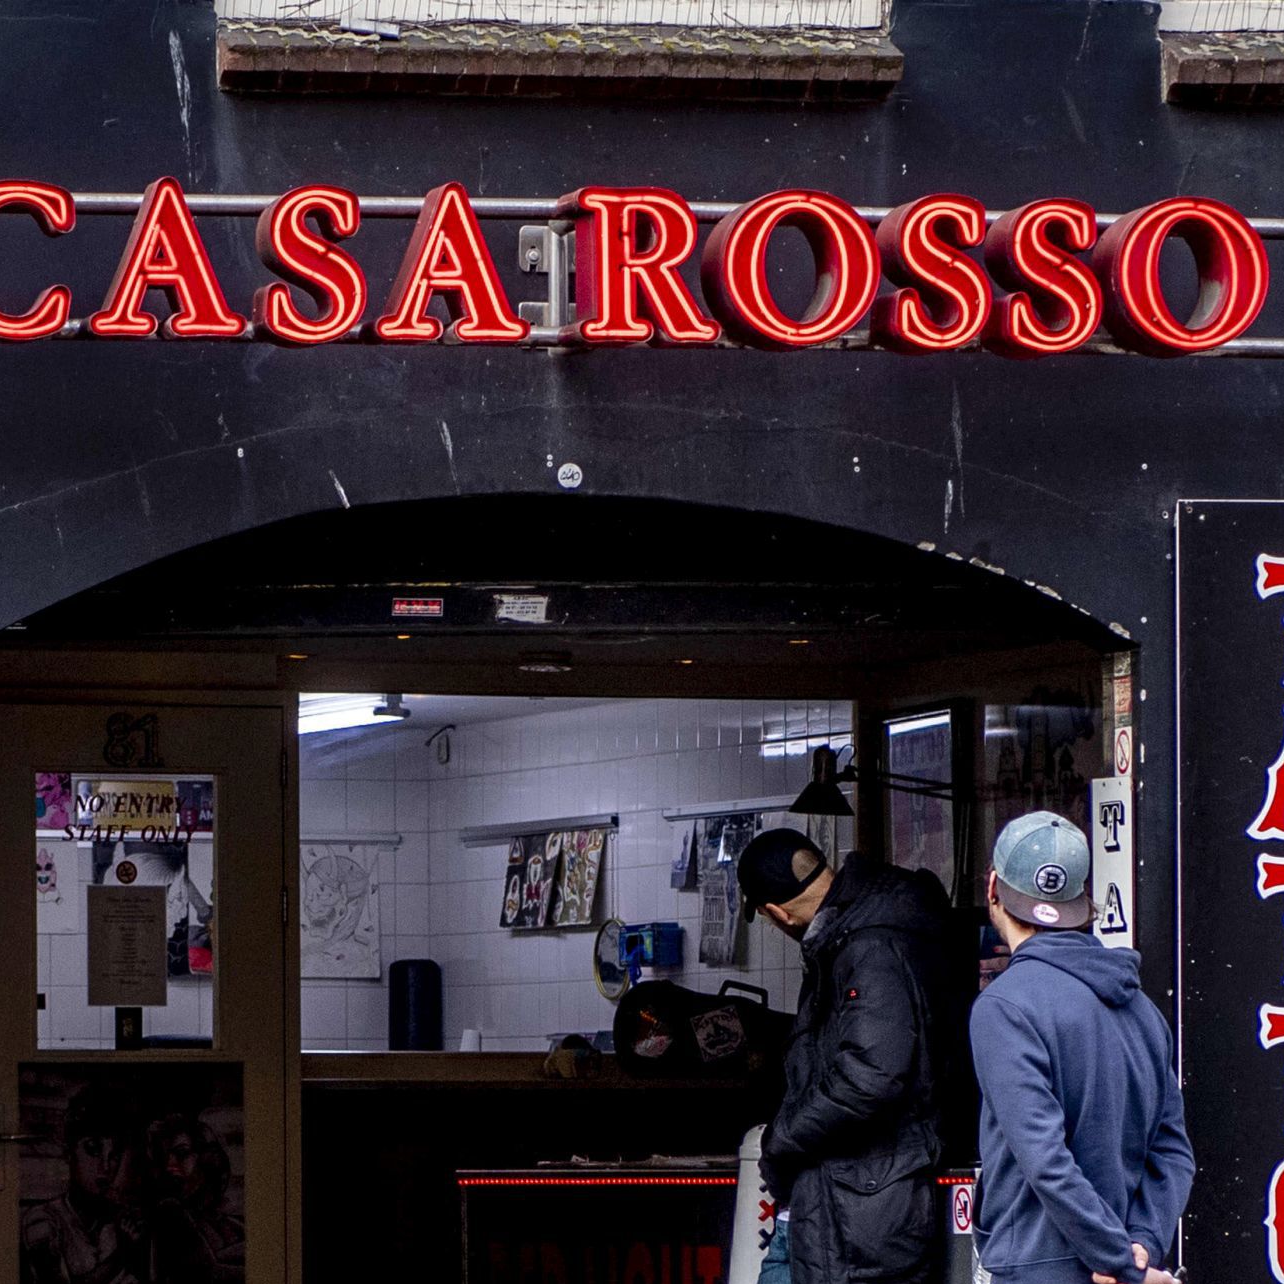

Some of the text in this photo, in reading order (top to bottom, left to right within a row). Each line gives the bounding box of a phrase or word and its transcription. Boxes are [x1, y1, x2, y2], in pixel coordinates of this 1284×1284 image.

[557, 185, 1270, 357] ROSSO
[74, 793, 187, 814] NO ENTRY
[62, 824, 198, 844] STAFF ONLY
